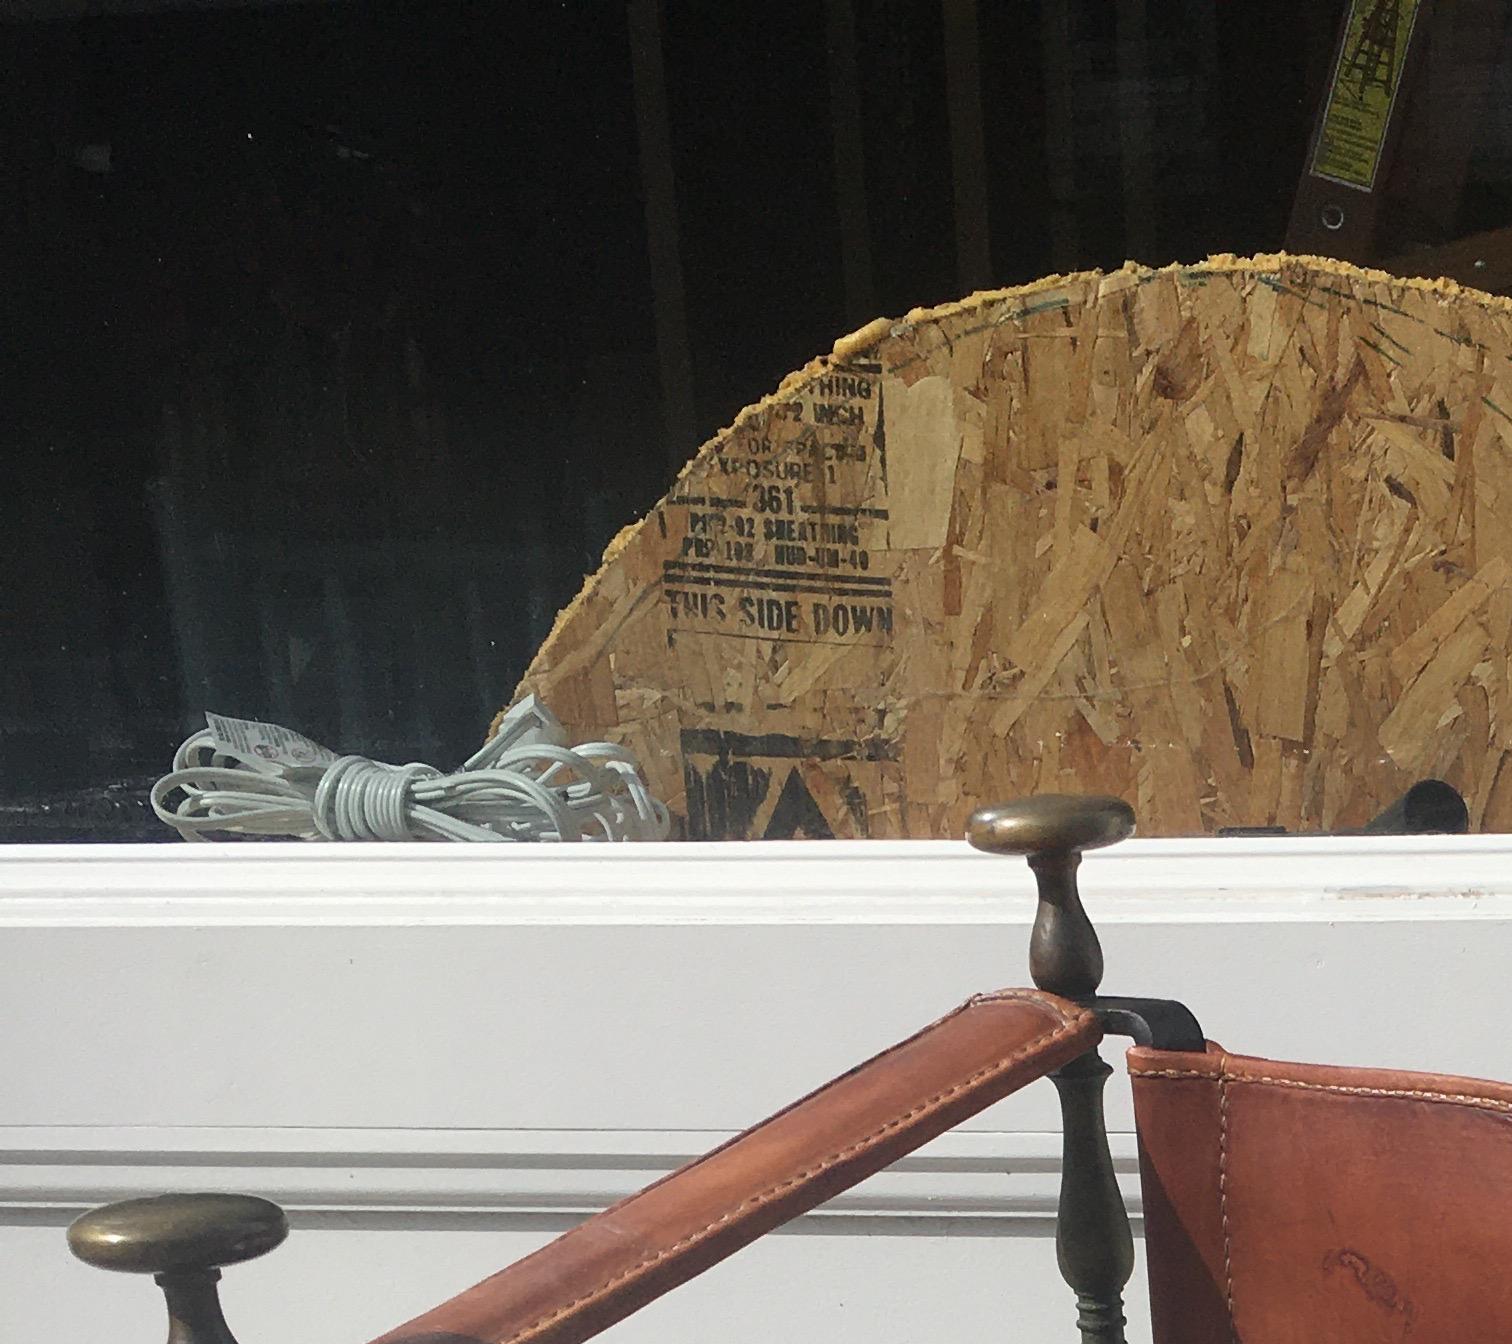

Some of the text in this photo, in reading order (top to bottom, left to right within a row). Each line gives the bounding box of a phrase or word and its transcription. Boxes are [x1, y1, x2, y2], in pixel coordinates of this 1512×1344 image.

[752, 483, 794, 515] 361
[763, 517, 860, 546] SHEATHING
[664, 589, 894, 638] THIS SIDE DOWN
